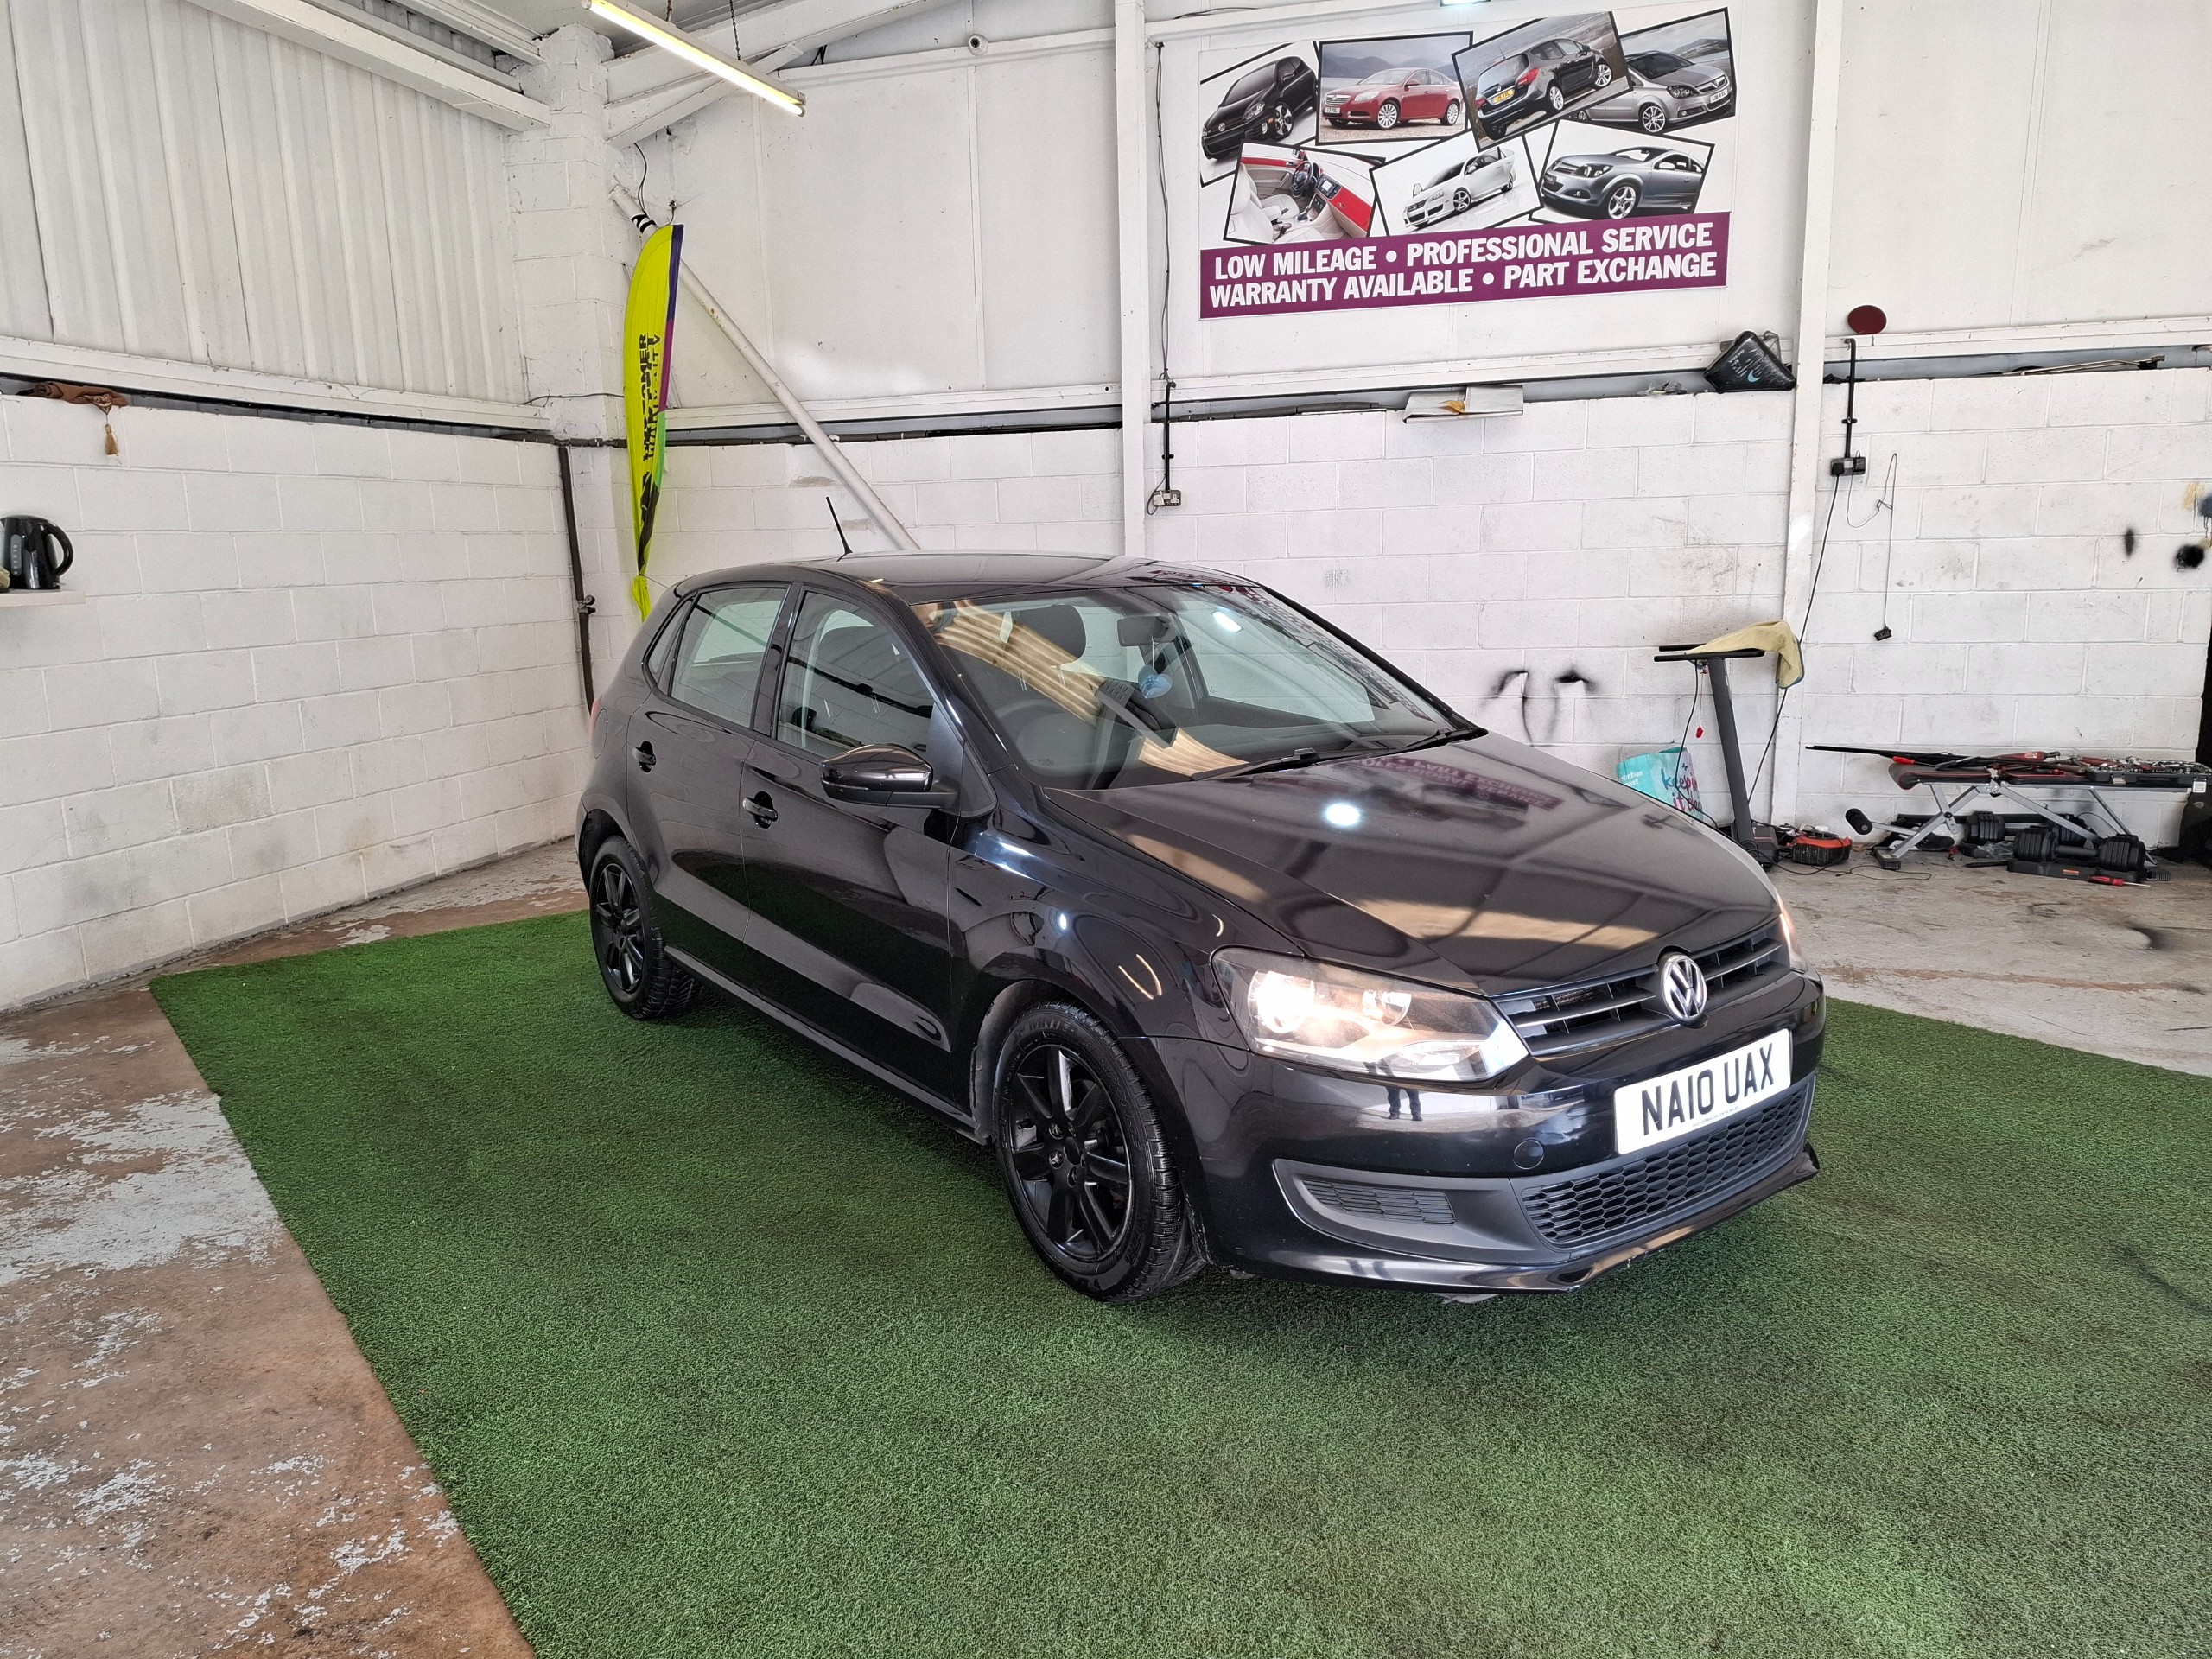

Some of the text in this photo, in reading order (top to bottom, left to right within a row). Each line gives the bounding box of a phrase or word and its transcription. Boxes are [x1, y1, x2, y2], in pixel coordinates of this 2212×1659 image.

[1209, 251, 1718, 308] WARRANTY AVAILABLE PART EXCHANGE
[1214, 221, 1713, 280] LOW MILEAGE PROFESSIONAL SERVICE
[1642, 1042, 1774, 1136] NA10 UAX
